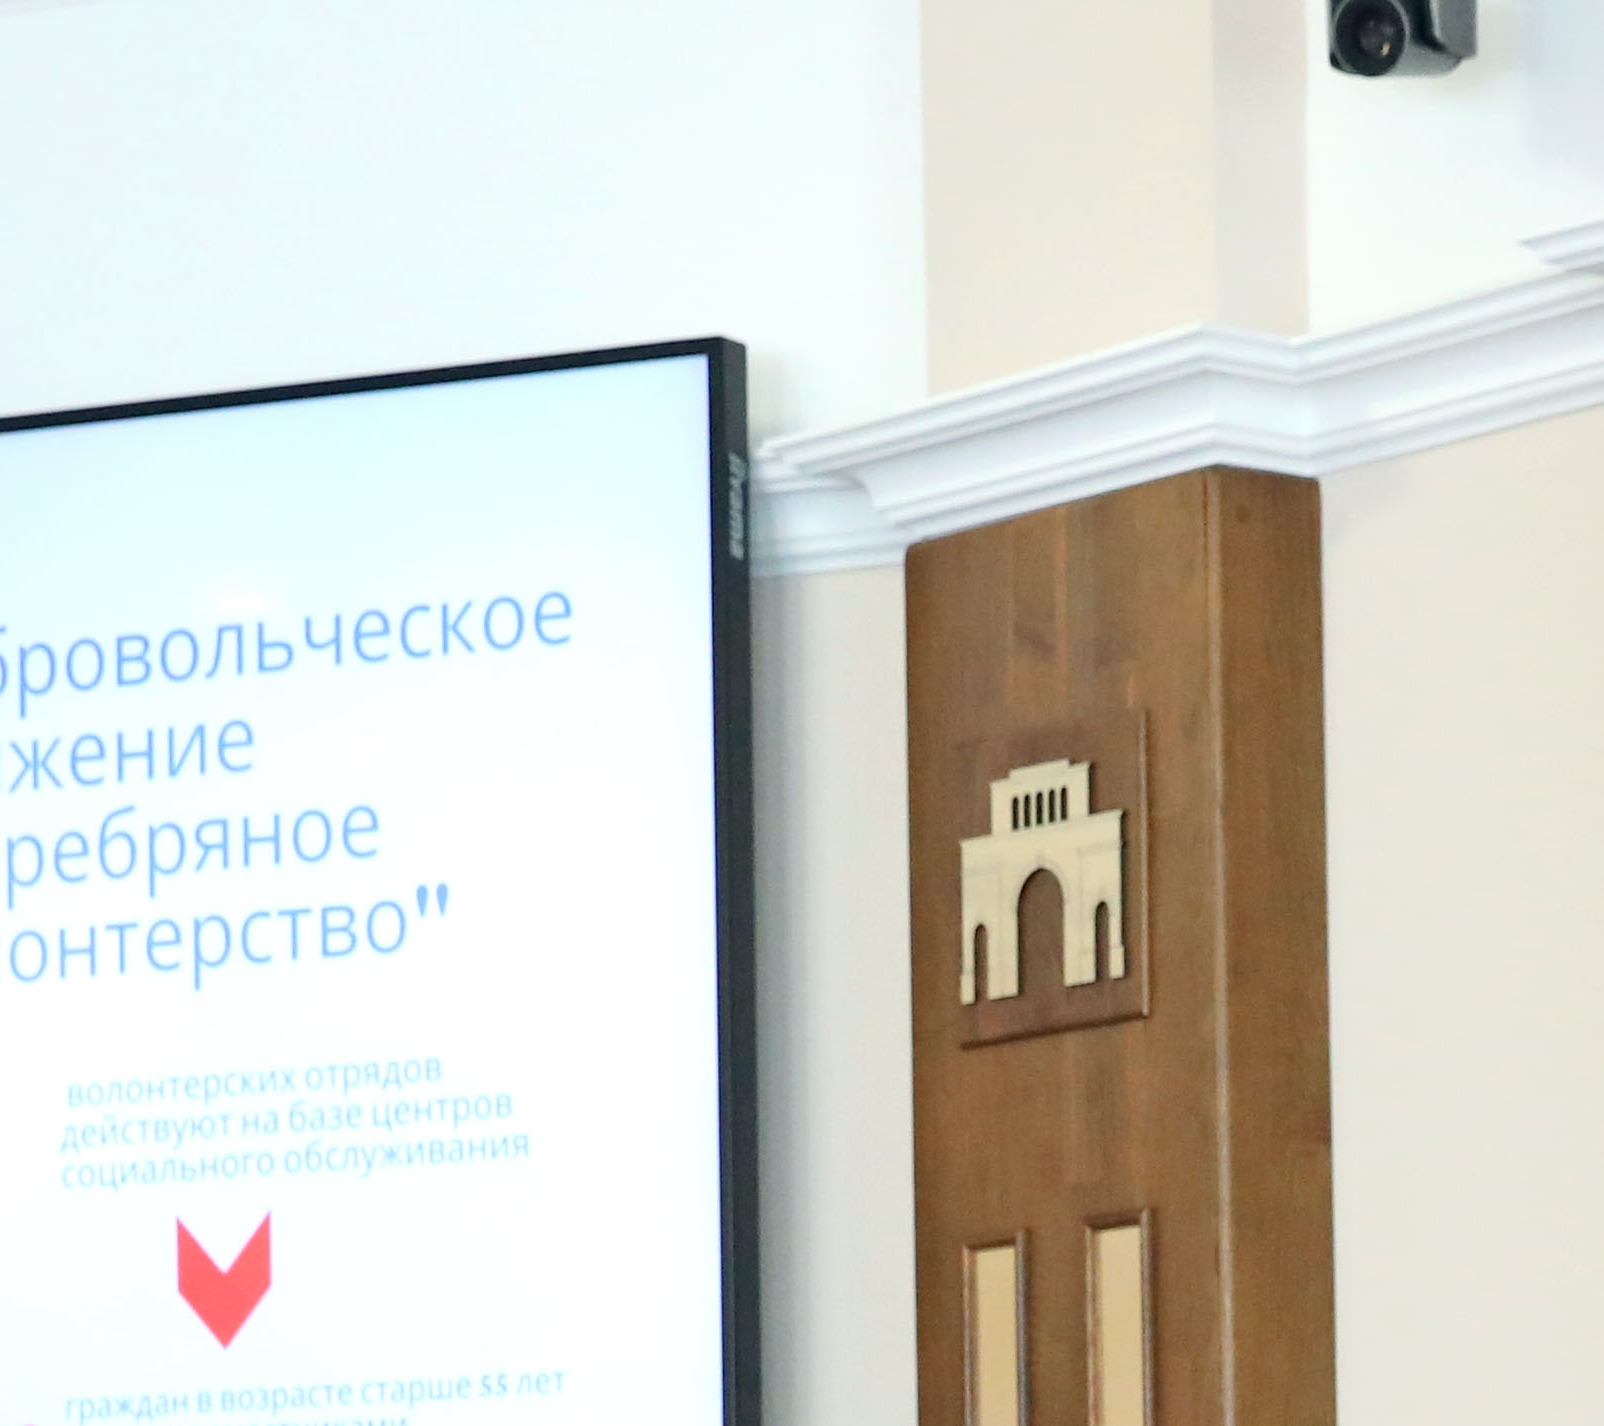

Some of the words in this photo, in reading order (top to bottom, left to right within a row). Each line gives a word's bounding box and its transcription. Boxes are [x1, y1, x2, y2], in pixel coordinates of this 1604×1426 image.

[67, 1069, 296, 1107] волонтерских
[304, 1057, 442, 1097] отрядов
[59, 1112, 231, 1156] действуют
[241, 1107, 280, 1136] на
[288, 1098, 363, 1134] базе
[372, 1092, 514, 1132] центров
[61, 1150, 276, 1195] социального
[283, 1131, 530, 1180] обслуживания
[197, 1387, 213, 1414] в
[220, 1381, 353, 1418] возрасте
[360, 1376, 472, 1411] старше
[478, 1371, 509, 1399] 55
[515, 1368, 568, 1397] лет
